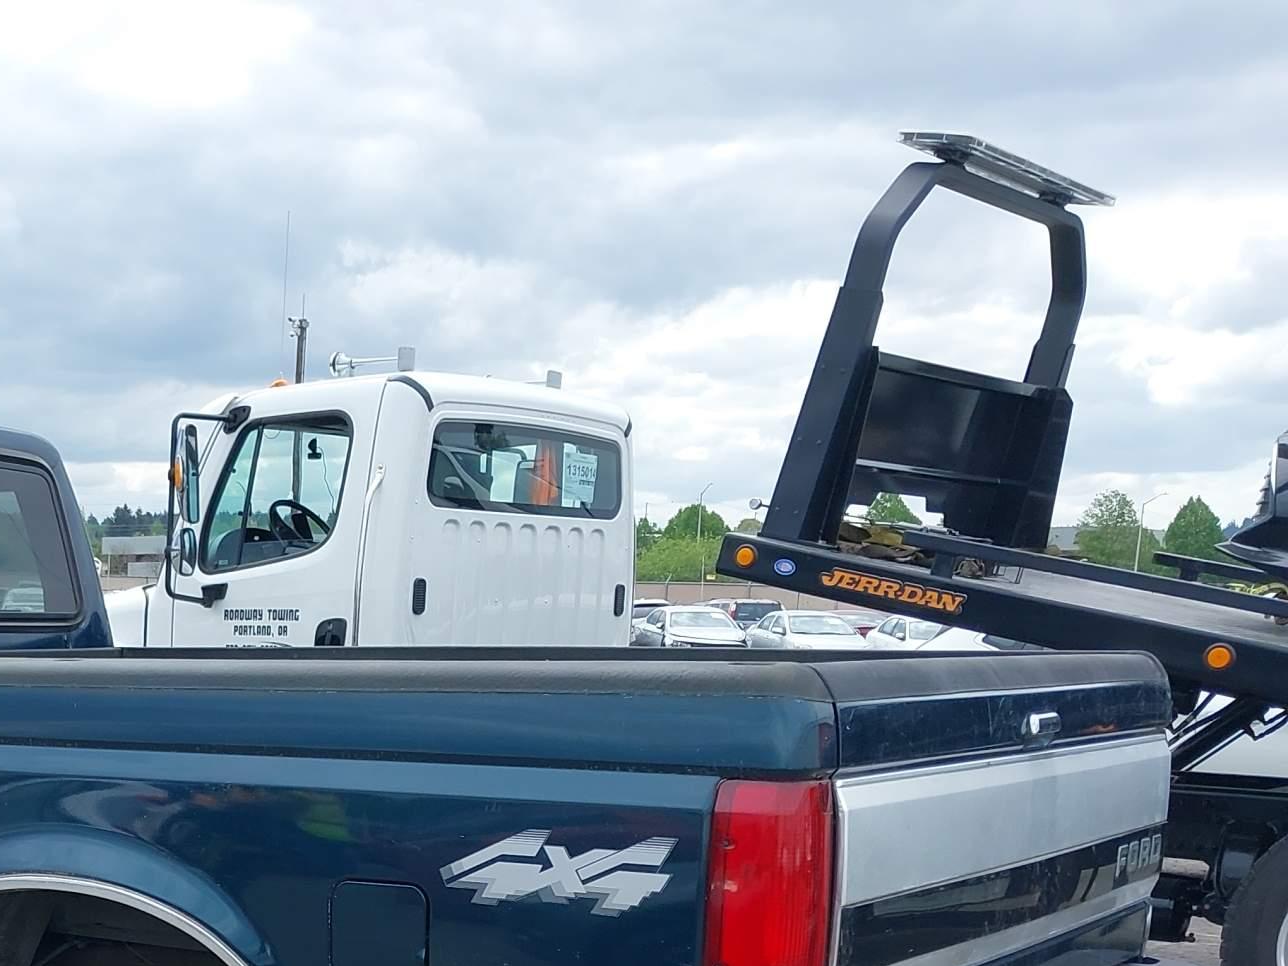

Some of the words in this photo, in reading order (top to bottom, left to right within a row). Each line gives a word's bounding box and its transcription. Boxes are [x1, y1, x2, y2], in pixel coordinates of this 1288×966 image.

[223, 609, 263, 621] ROADWAY
[267, 609, 300, 621] TOWING
[233, 625, 274, 637] PORTLAND,
[278, 625, 288, 636] OR
[1115, 833, 1162, 877] FORD
